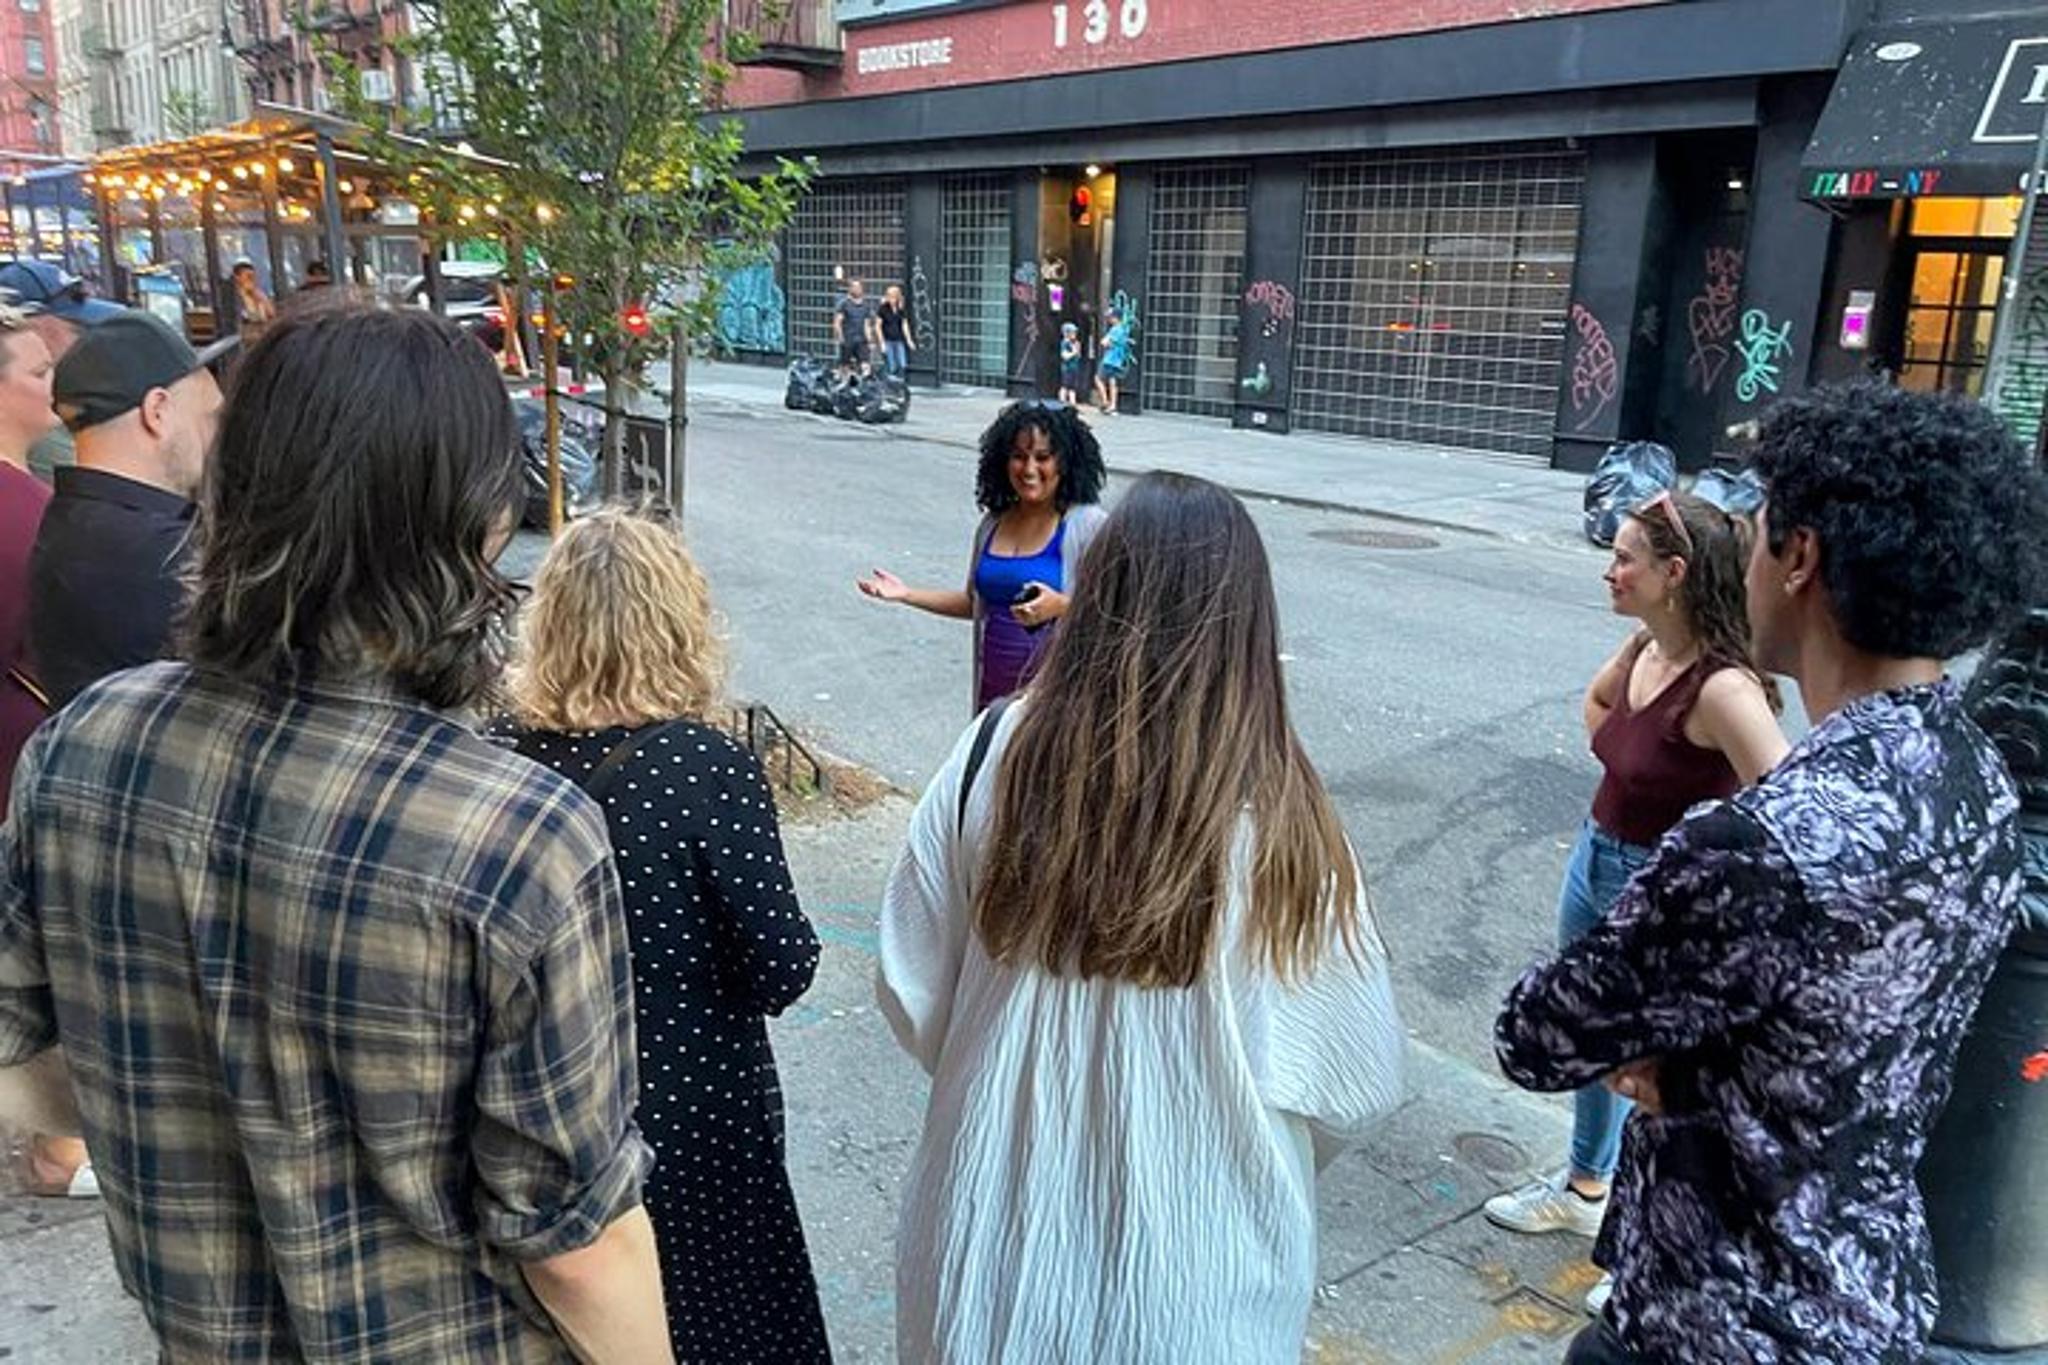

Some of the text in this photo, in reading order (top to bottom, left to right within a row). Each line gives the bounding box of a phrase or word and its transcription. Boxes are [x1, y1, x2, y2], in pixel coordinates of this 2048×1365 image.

[1052, 0, 1148, 48] 130
[858, 37, 953, 73] BOOKSTORE
[1812, 169, 1878, 196] ITALY
[1903, 169, 1941, 195] NY
